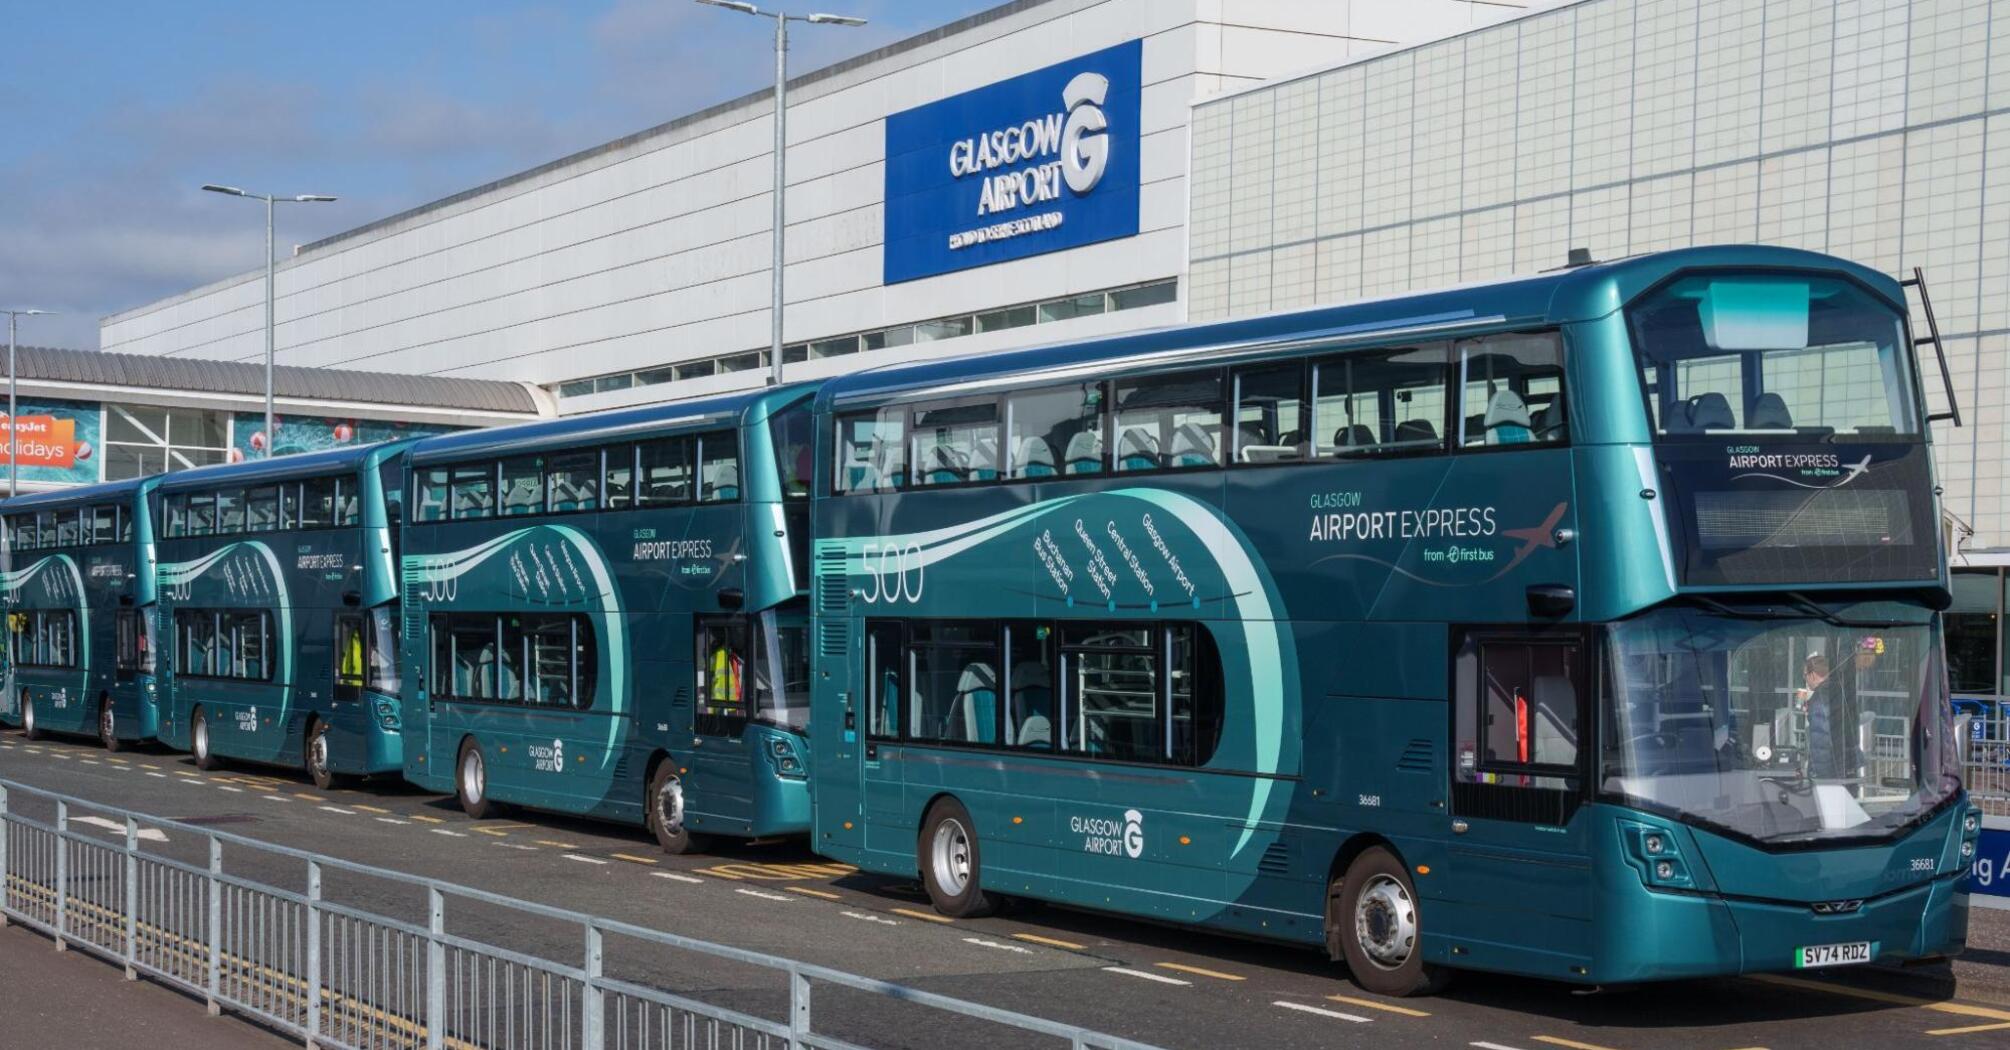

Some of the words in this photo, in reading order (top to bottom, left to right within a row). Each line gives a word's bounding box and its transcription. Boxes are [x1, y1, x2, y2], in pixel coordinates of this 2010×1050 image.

[950, 113, 1063, 177] GLASGOW
[977, 160, 1063, 216] AIRPORT
[0, 440, 64, 460] olidays
[1726, 446, 1760, 454] GLASGOW
[1729, 455, 1783, 468] AIRPORT
[1784, 454, 1839, 468] EXPRESS
[1310, 492, 1362, 508] GLASGOW
[1310, 512, 1397, 541] AIRPORT
[1401, 506, 1496, 538] EXPRESS
[633, 541, 671, 560] AIRPORT
[671, 540, 712, 559] EXPRESS
[1034, 537, 1047, 562] Bus
[1045, 556, 1068, 595] Station
[1042, 529, 1074, 582] Buchanan
[1075, 518, 1096, 555] Queen
[1094, 549, 1117, 586] Street
[1107, 520, 1132, 561] Central
[1129, 554, 1154, 596] Station
[1143, 513, 1171, 559] Glasgow
[1168, 555, 1195, 597] Airport
[1424, 548, 1445, 561] from
[1460, 547, 1478, 561] first
[1478, 547, 1494, 560] bus
[425, 558, 457, 602] 500
[862, 542, 924, 603] 500
[1087, 560, 1111, 600] Station
[1071, 816, 1123, 838] GLASGOW
[1084, 836, 1123, 857] AIRPORT
[1910, 858, 1934, 871] 36681
[1805, 946, 1838, 964] SV74
[1842, 943, 1867, 961] RDZ
